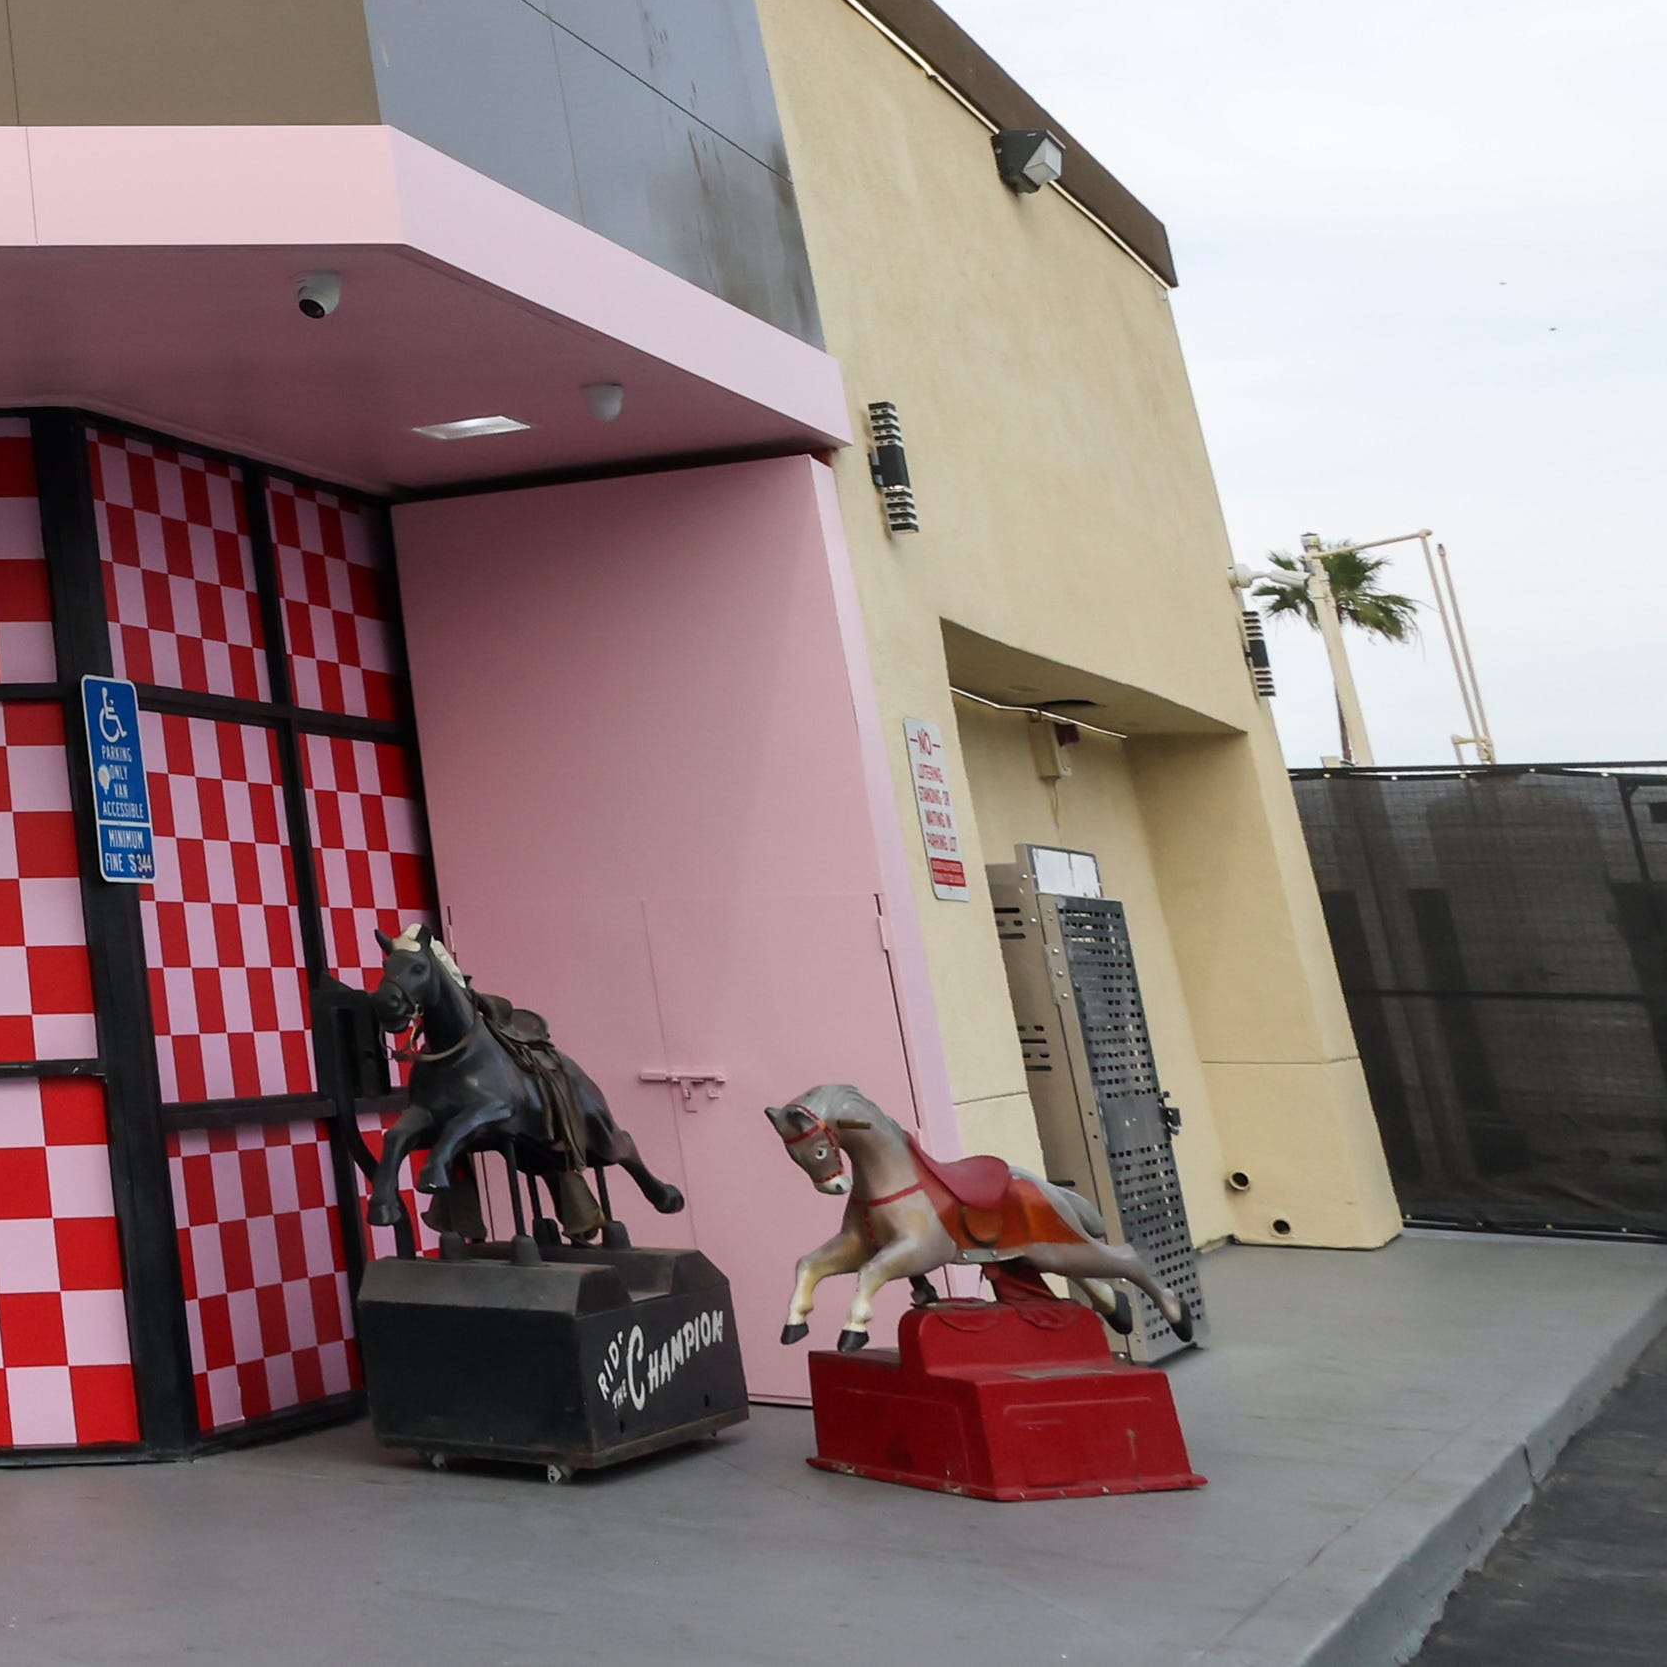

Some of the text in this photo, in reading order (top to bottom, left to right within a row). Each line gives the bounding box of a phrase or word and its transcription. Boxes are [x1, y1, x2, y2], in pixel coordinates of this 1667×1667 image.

[103, 746, 132, 762] PARKING
[108, 766, 127, 780] ONLY
[115, 784, 128, 799] VAN
[103, 802, 143, 818] ACCESSIBLE
[109, 829, 143, 849] MINIMUM
[106, 853, 123, 872] FINE
[611, 1309, 724, 1412] THE CHAMPION
